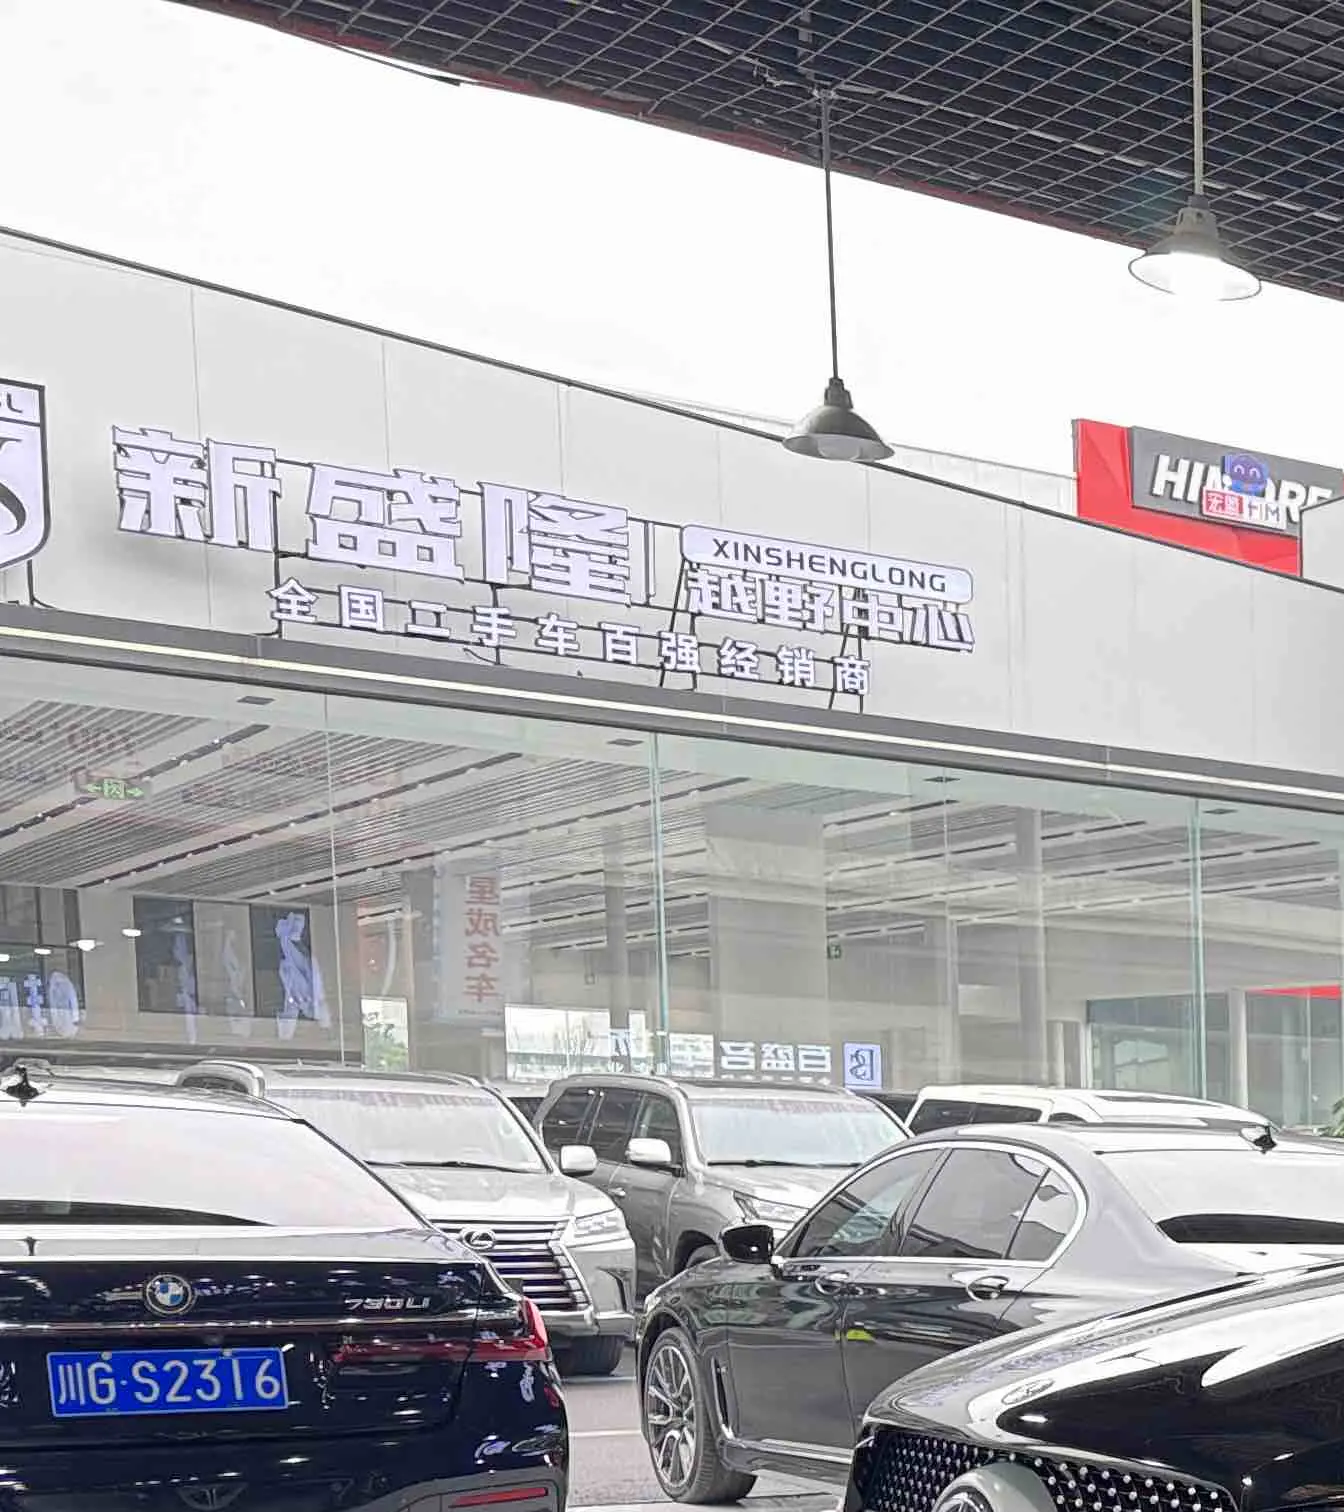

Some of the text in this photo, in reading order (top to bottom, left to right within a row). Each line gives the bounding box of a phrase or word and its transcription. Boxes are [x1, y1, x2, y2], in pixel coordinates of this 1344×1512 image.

[112, 425, 631, 607] 新盛隆
[712, 537, 947, 593] XINSHENGLONG
[269, 577, 871, 696] 全国二手车百强经销商
[686, 567, 975, 652] 越野中心
